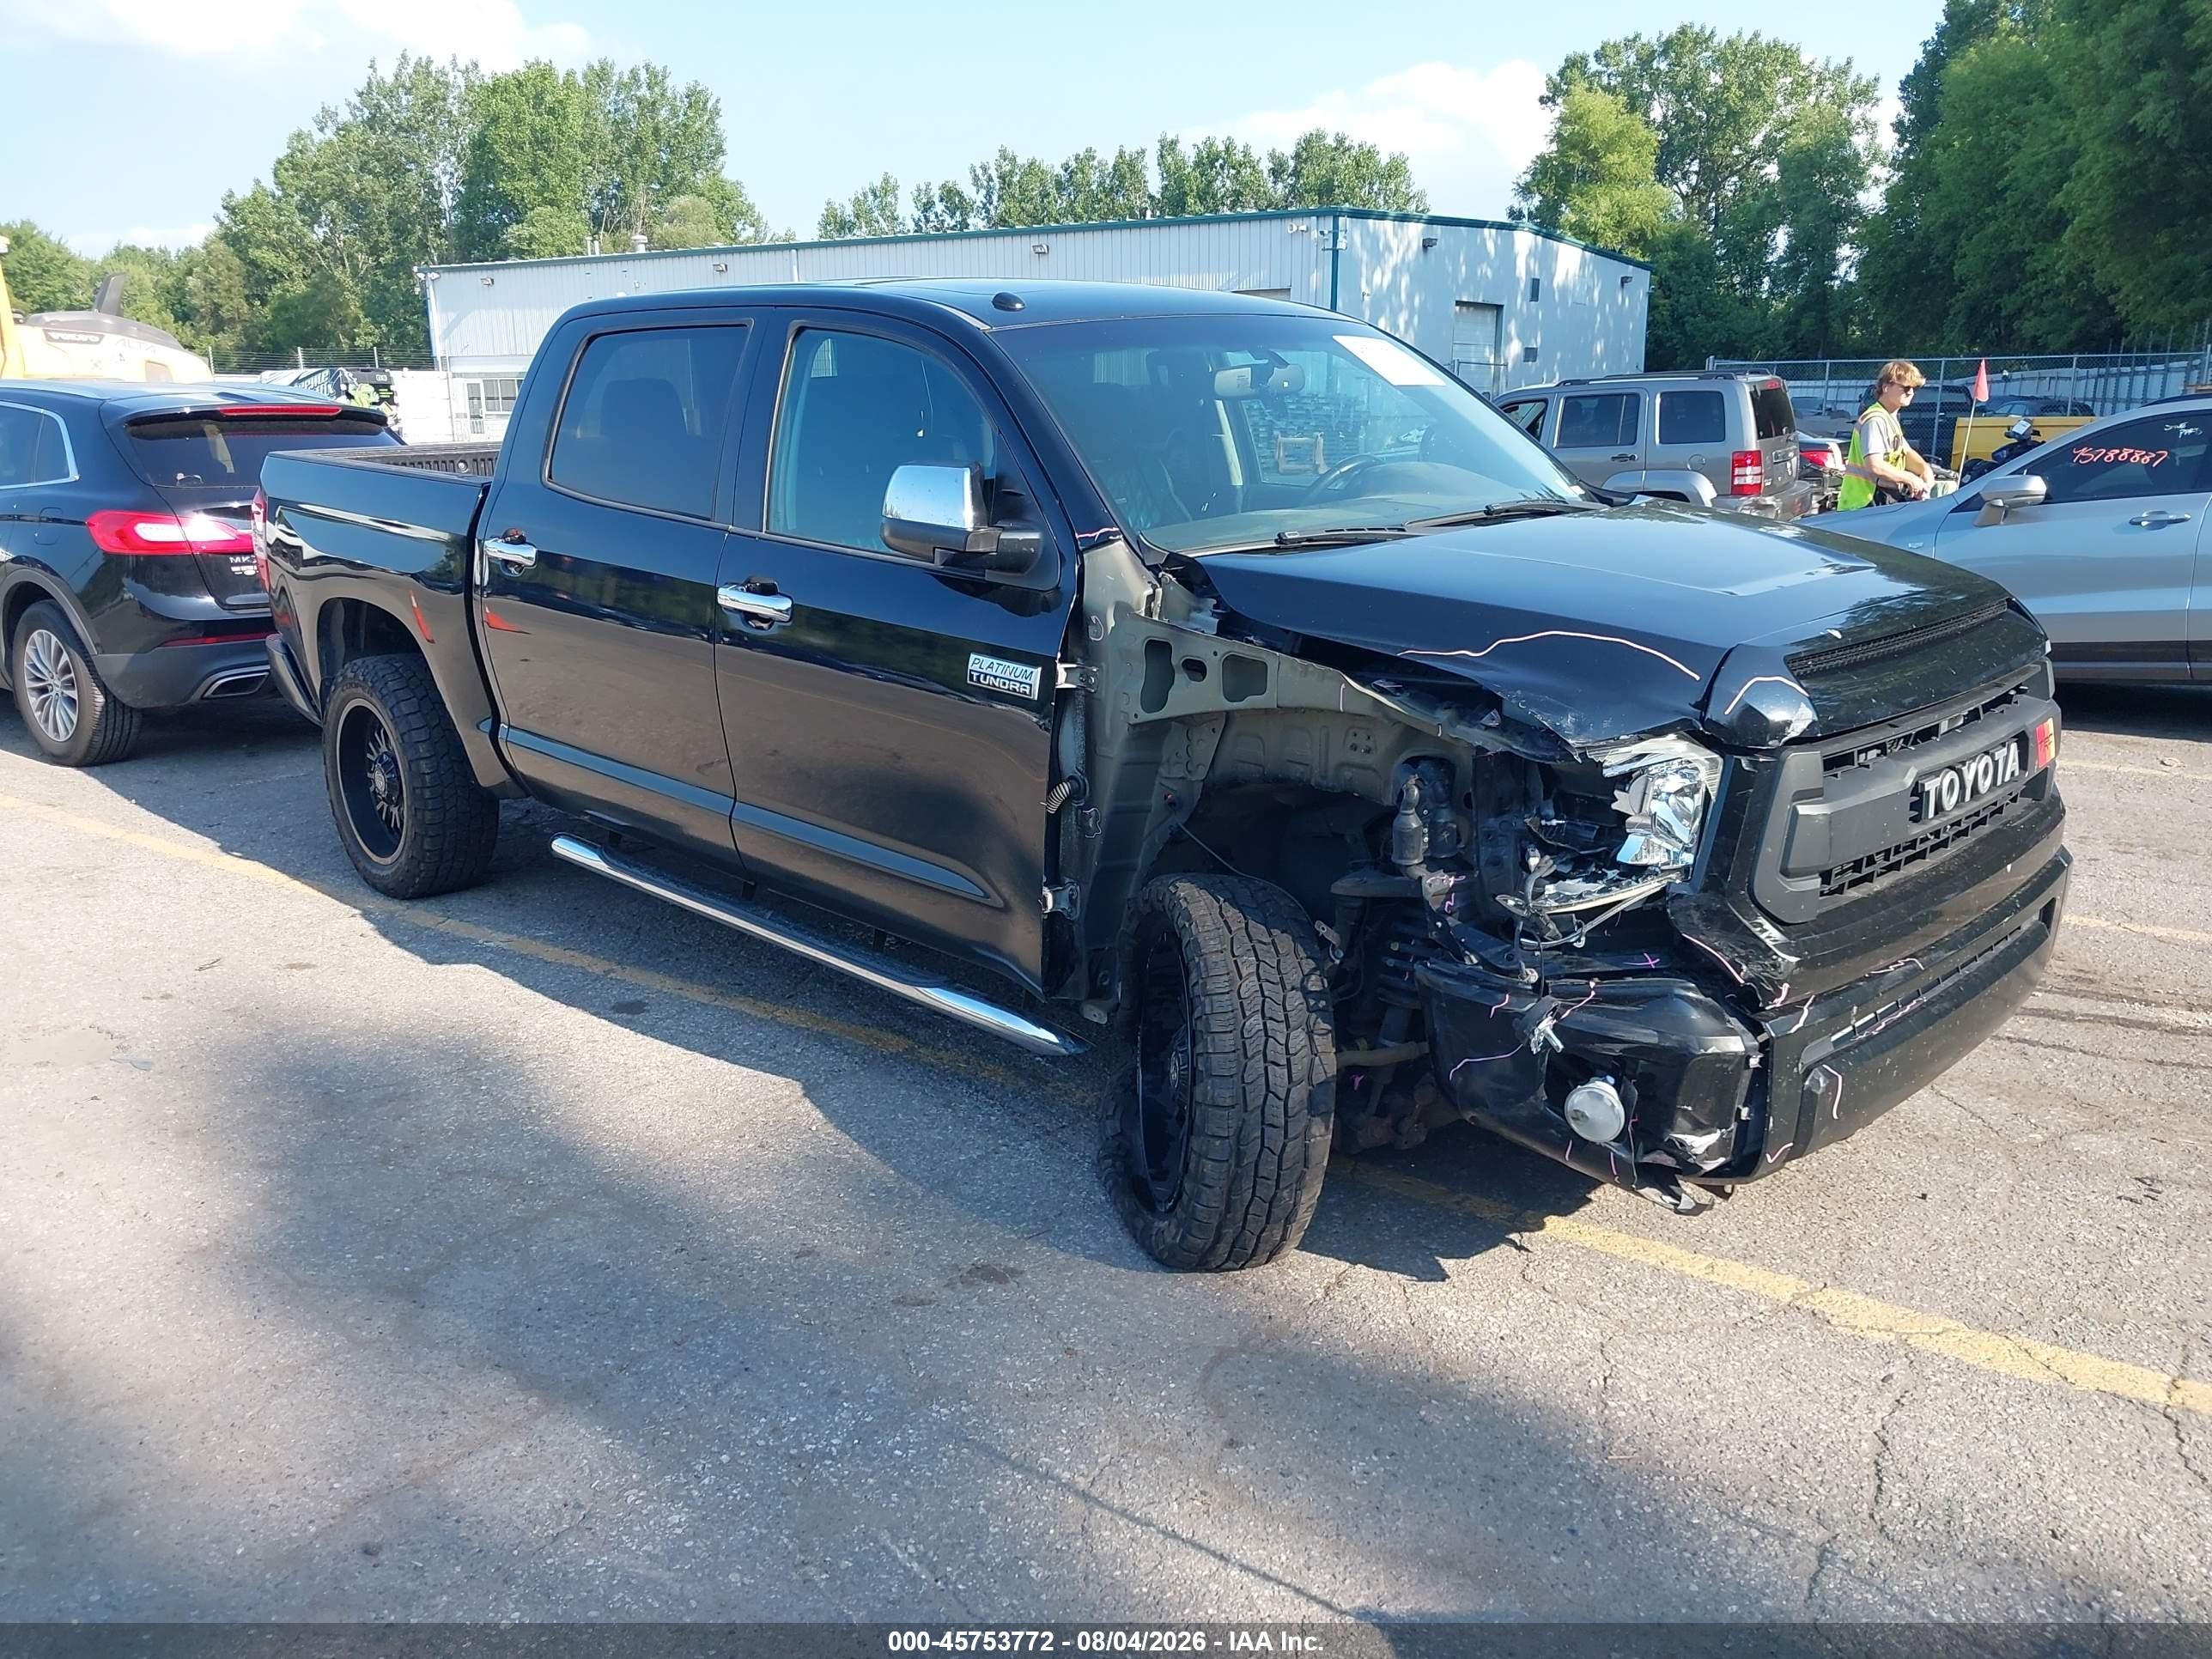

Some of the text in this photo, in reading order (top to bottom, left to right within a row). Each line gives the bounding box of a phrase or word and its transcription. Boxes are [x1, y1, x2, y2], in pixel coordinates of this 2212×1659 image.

[2072, 447, 2169, 468] 45788887
[971, 657, 1034, 682] PLATINUM
[970, 671, 1031, 696] TUNDRA
[1923, 741, 2020, 819] TOYOTA
